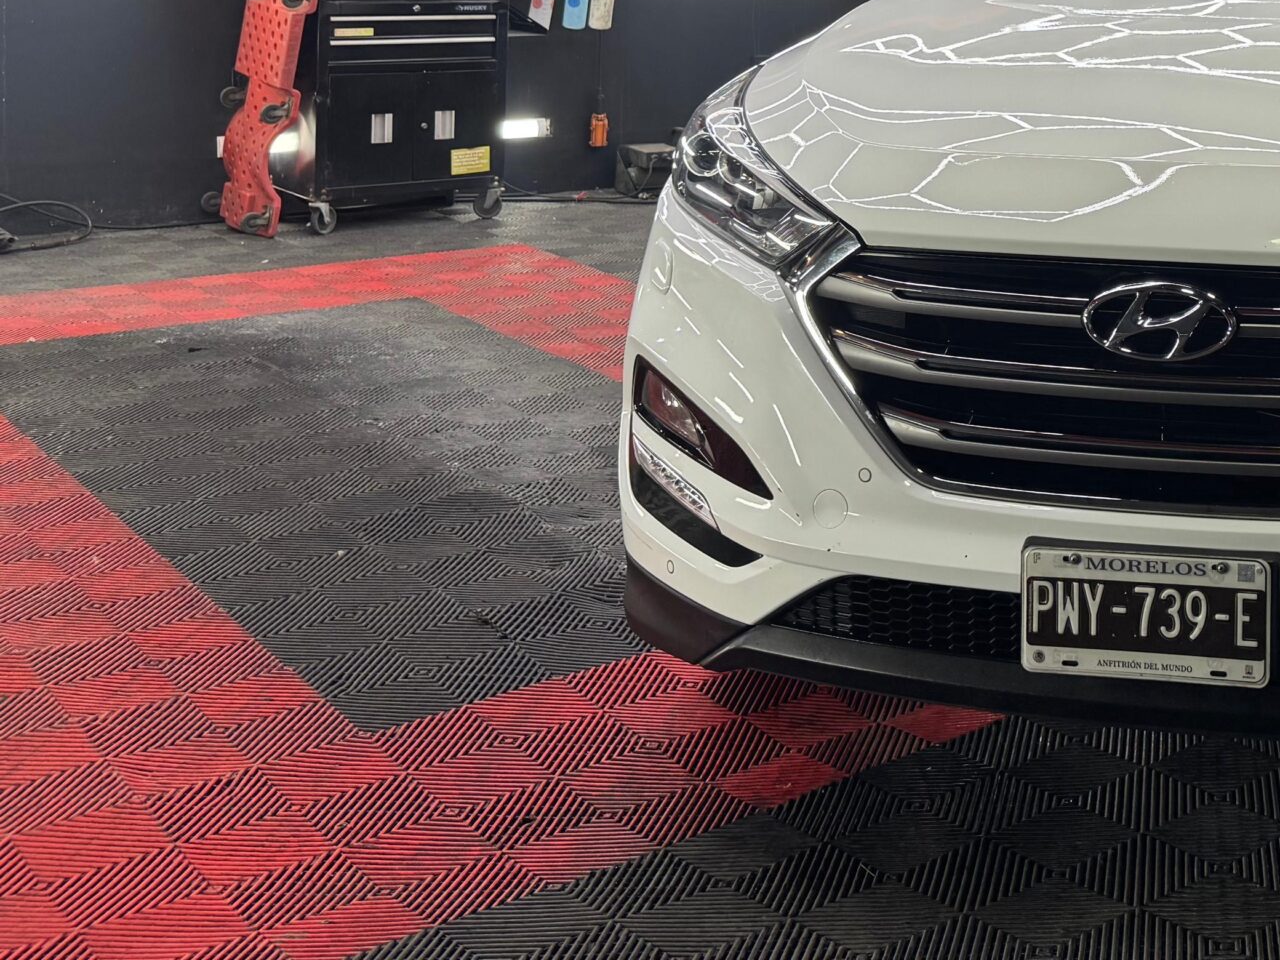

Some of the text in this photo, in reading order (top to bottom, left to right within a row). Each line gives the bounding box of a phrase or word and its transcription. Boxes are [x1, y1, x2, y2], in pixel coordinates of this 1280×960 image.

[1085, 557, 1207, 577] MORELOS
[1032, 580, 1259, 648] PWY-739-E
[1097, 659, 1193, 673] ANFITRIÓN DEL MUNDO
